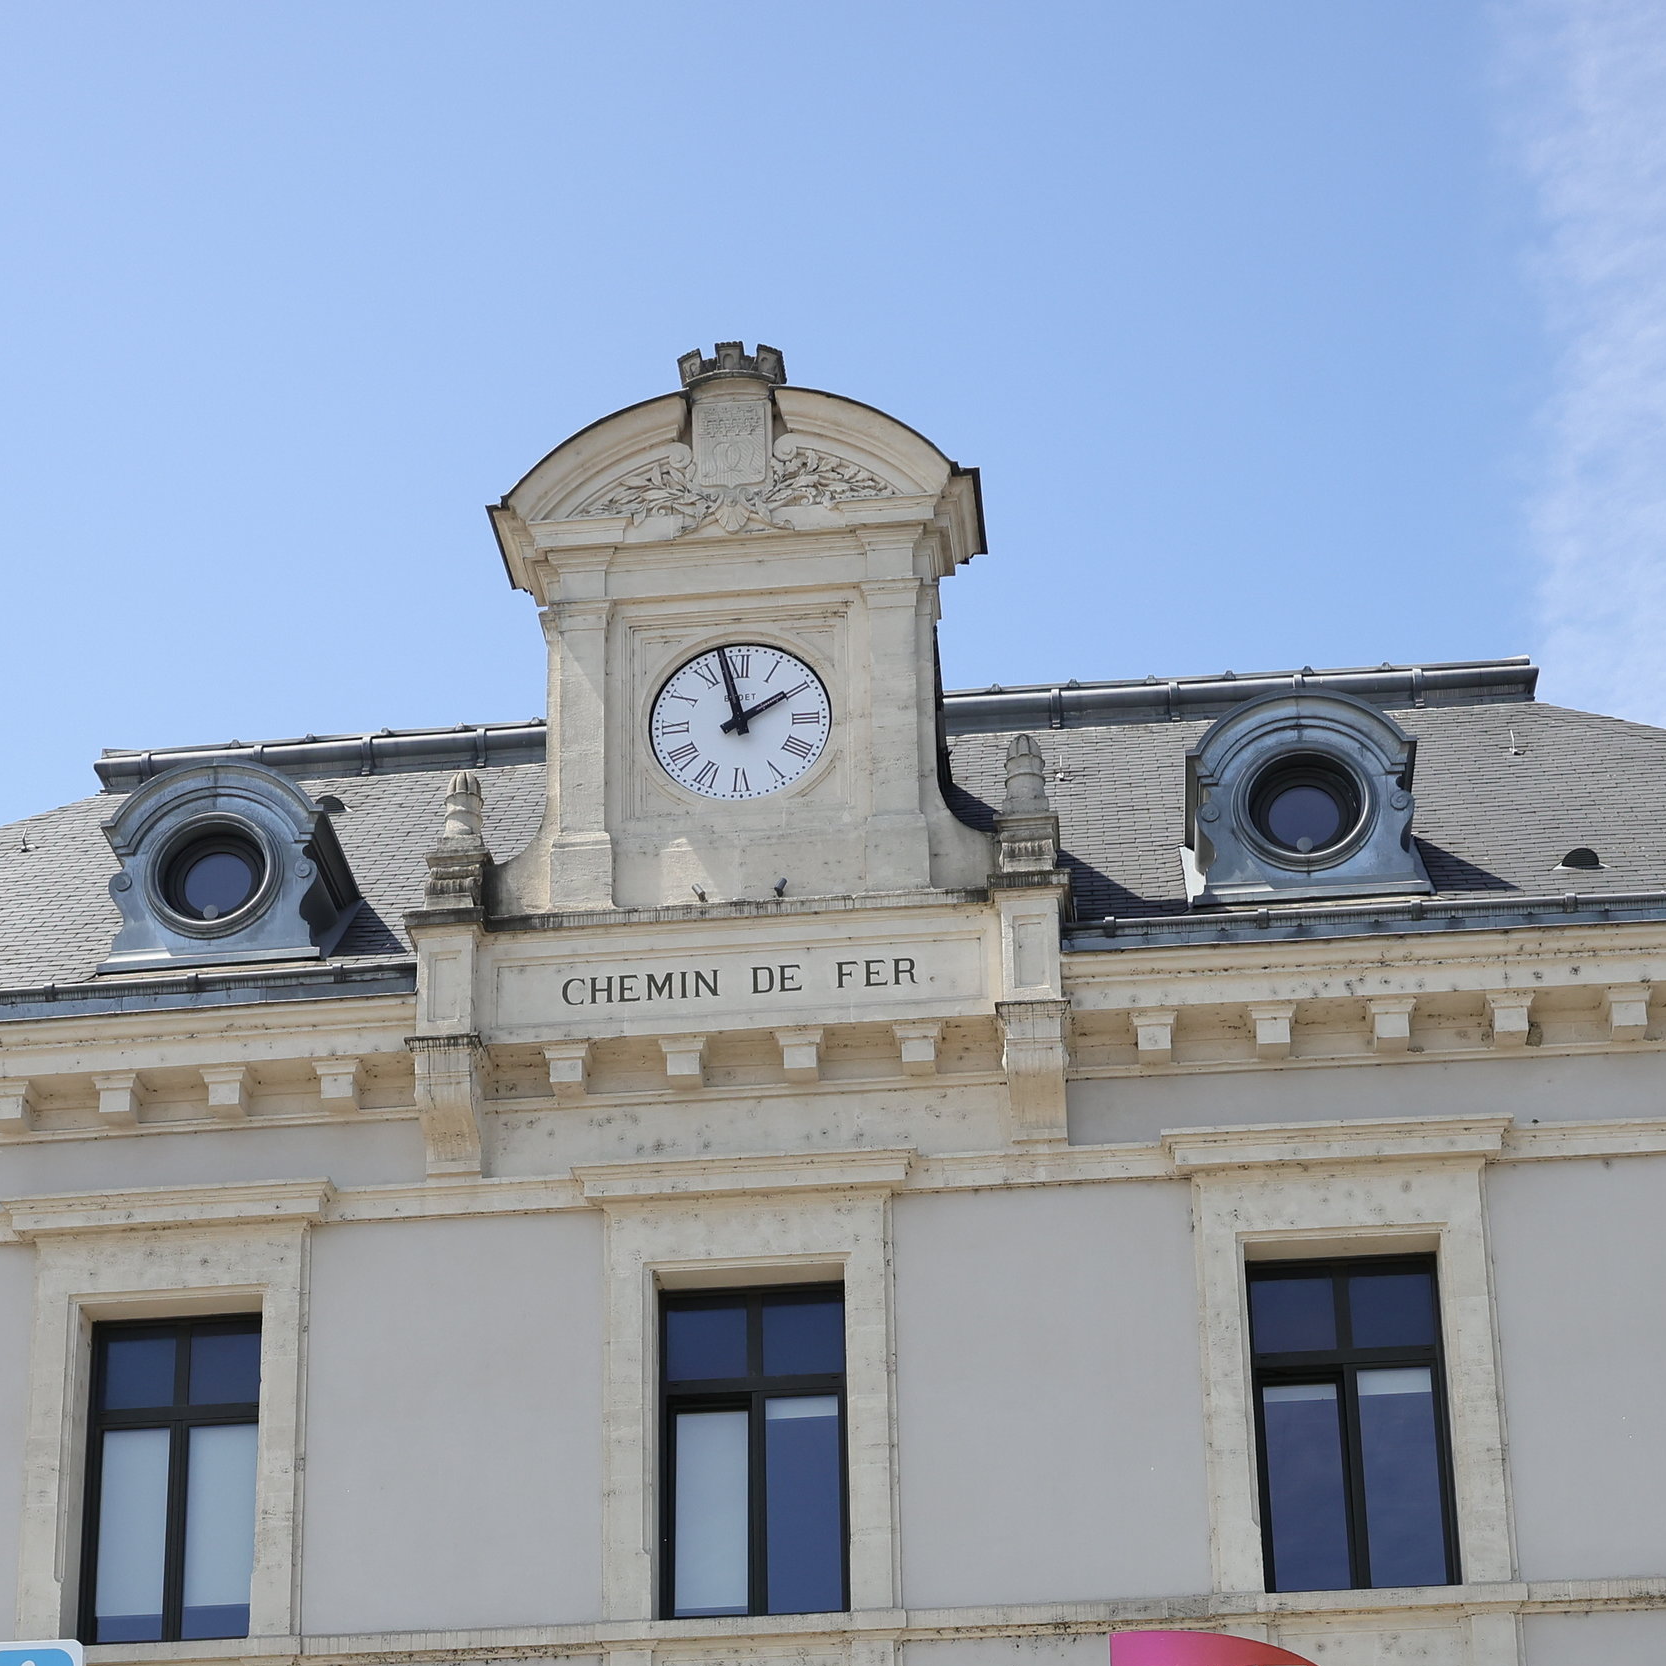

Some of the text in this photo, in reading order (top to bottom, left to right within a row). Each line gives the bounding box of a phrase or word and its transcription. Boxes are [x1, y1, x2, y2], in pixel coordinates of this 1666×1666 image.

[763, 660, 782, 683] I
[669, 689, 699, 708] X
[724, 693, 756, 703] BDET
[562, 957, 919, 1006] CHEMIN DE FER
